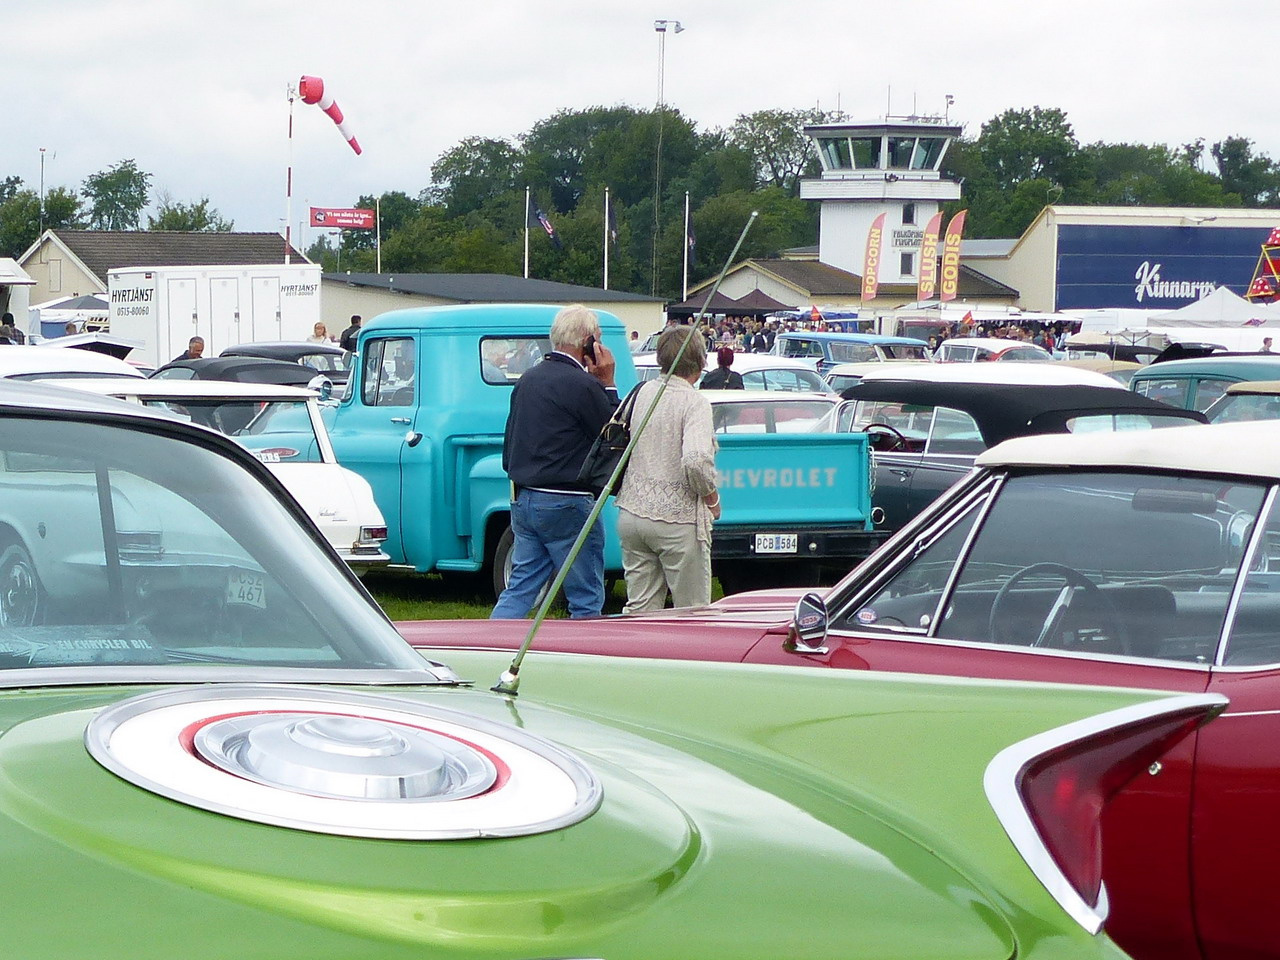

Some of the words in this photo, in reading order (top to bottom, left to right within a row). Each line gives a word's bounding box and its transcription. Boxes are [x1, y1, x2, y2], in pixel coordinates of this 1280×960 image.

[865, 228, 882, 294] POPCORN
[920, 233, 938, 292] SLUSH
[942, 233, 961, 295] GODIS
[111, 287, 154, 303] HYRTJÄNST
[116, 306, 150, 316] 0515-80060
[717, 467, 838, 489] HEVROLET
[756, 536, 774, 549] PCB
[781, 536, 797, 549] 584
[237, 586, 263, 602] 467
[73, 638, 130, 650] CHRYSLER
[131, 639, 153, 650] BIL
